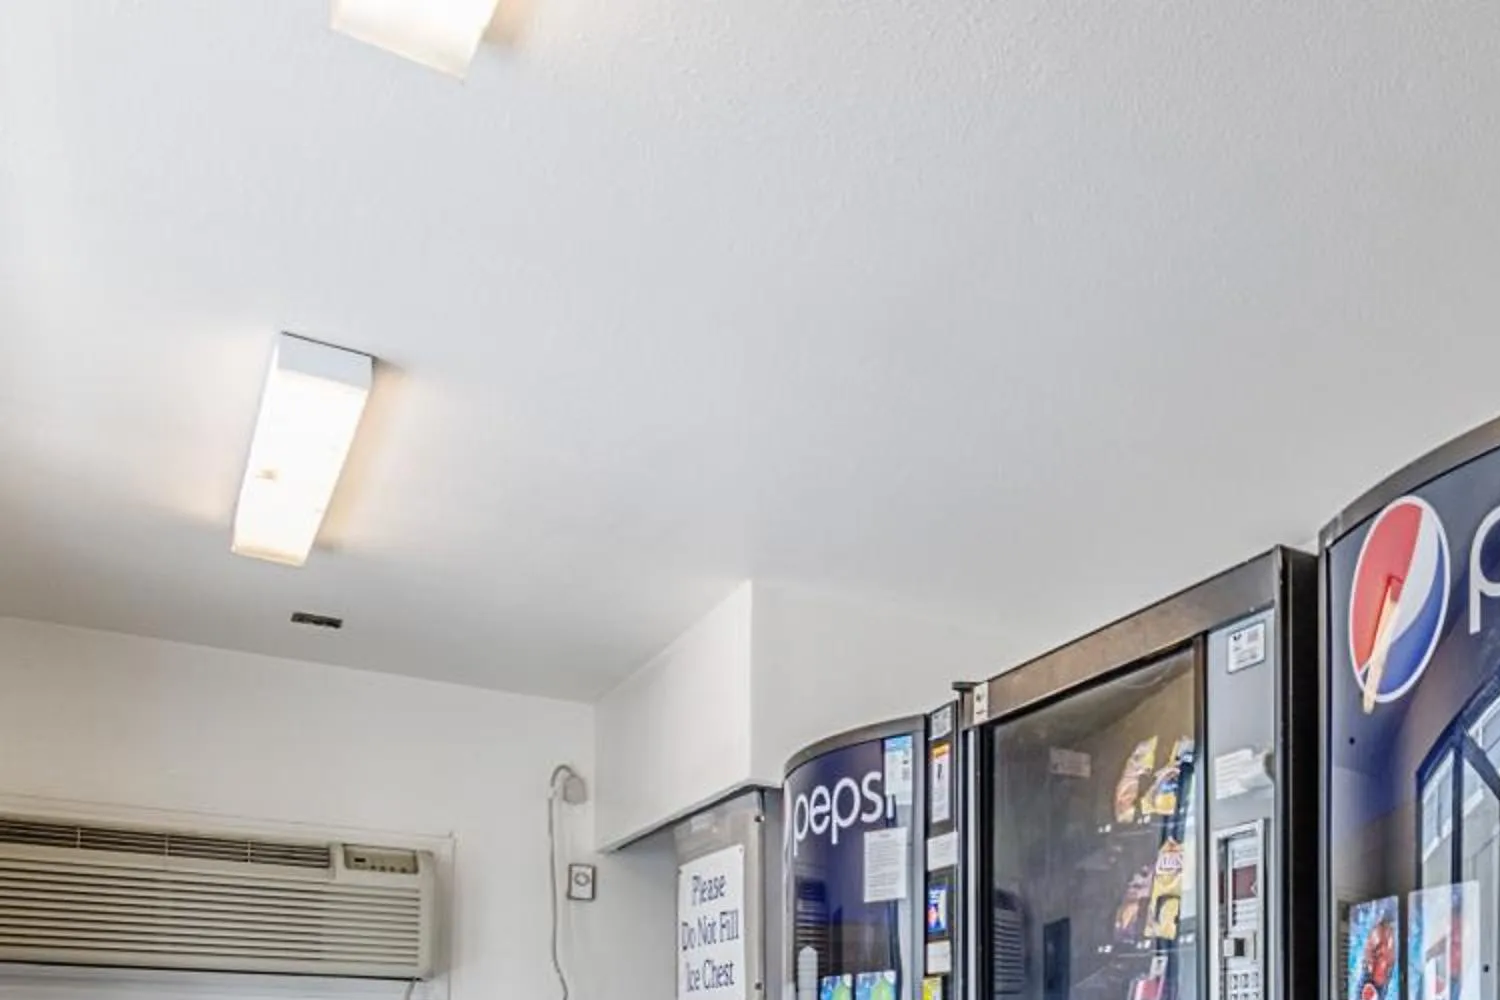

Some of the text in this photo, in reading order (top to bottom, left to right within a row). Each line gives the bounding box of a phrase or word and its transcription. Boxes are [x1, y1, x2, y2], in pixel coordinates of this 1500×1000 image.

[691, 874, 726, 906] Please
[681, 909, 740, 951] Do Not Fill
[686, 958, 735, 993] Ice Chest
